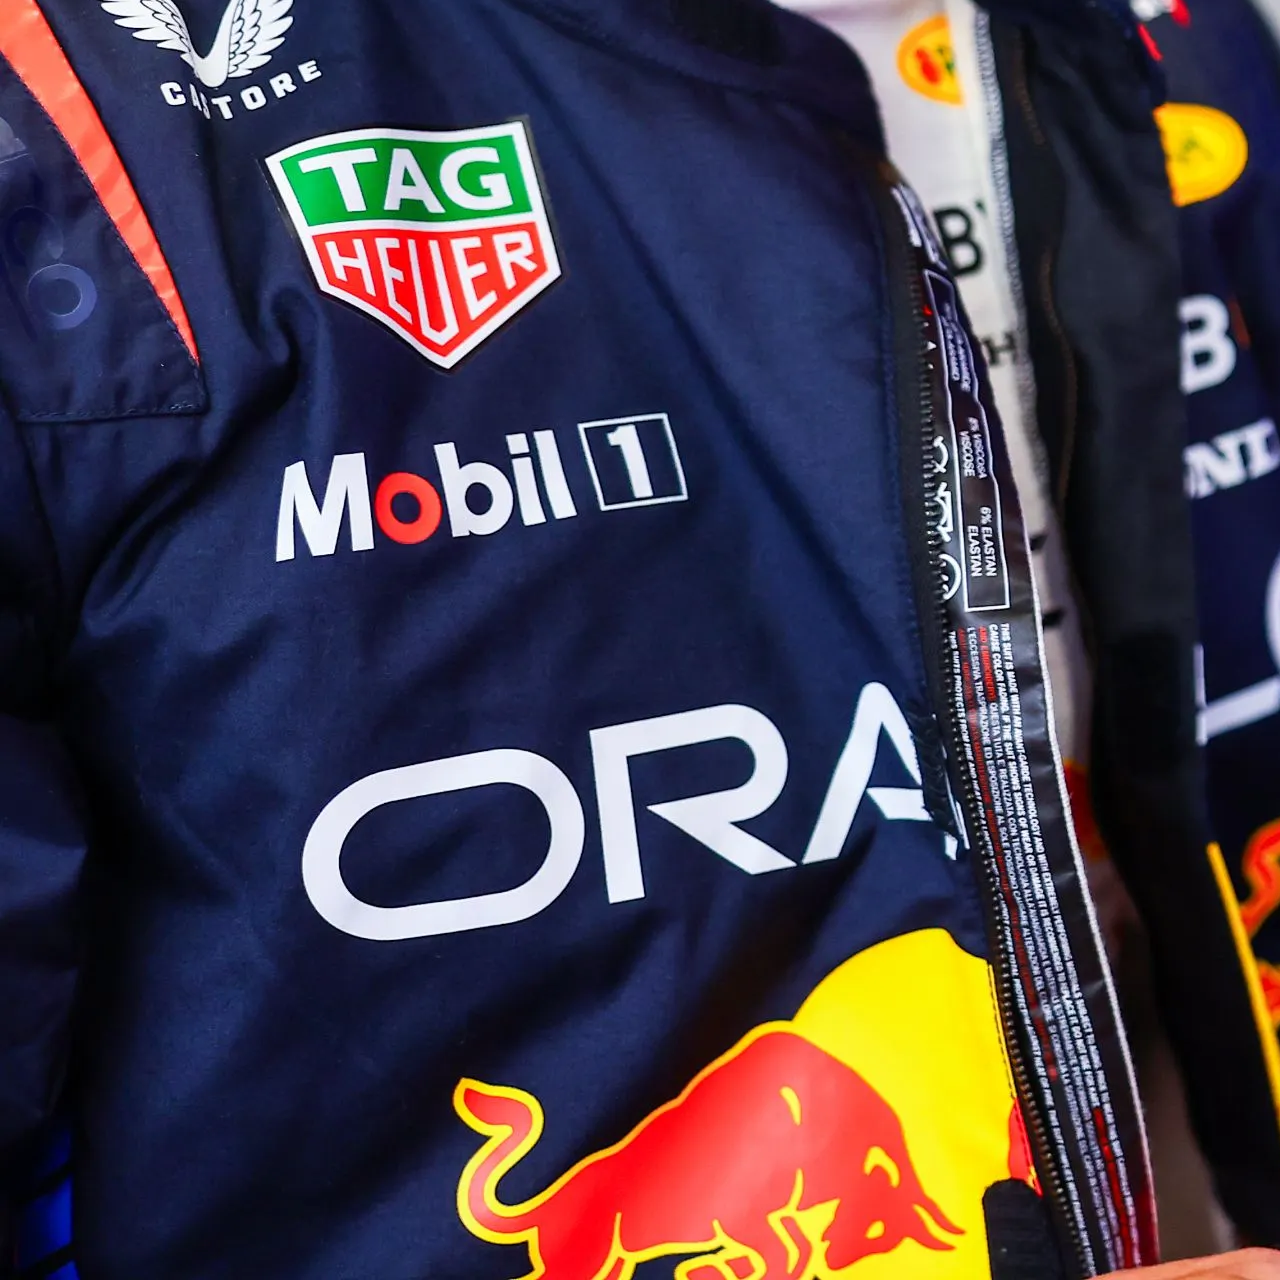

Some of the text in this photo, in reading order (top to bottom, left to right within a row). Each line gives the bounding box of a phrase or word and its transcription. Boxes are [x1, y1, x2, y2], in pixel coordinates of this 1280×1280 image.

[298, 146, 514, 214] TAG
[324, 230, 538, 346] HEUER
[275, 423, 653, 563] Mobil 1
[966, 524, 982, 577] ELASTAN
[979, 505, 996, 577] 6% ELASTAN
[988, 623, 1000, 652] CAUSE
[1000, 622, 1010, 641] THIS
[967, 626, 980, 680] L'ECCESSIVA
[1002, 642, 1012, 661] SUIT
[991, 652, 1004, 681] COLOR
[1004, 660, 1013, 670] IS
[1006, 670, 1018, 693] MADE
[953, 674, 965, 718] PROTECTS
[1010, 693, 1020, 715] WITH
[958, 718, 969, 742] FROM
[989, 702, 1000, 736] QUESTA
[1001, 713, 1010, 724] IF
[1002, 724, 1012, 741] THE
[983, 746, 993, 759] ED
[993, 737, 1003, 758] TUTA
[1003, 741, 1015, 759] SUIT
[1007, 759, 1020, 790] SHOWS
[985, 759, 1002, 815] ESPOSIZIONE
[998, 767, 1014, 816] REALIZZATA
[301, 681, 970, 940] ORA
[1013, 790, 1025, 816] SIGNS
[1023, 782, 1041, 836] TECHNOLOGY
[996, 814, 1004, 825] AL
[1007, 816, 1018, 836] CON
[1018, 816, 1028, 829] OF
[998, 826, 1009, 848] SOLE
[1020, 829, 1033, 854] WEAR
[1033, 835, 1044, 853] AND
[1003, 849, 1018, 889] POSSONO
[1011, 837, 1030, 888] TECNOLOGIA
[1026, 853, 1036, 867] OR
[1037, 853, 1049, 872] WITH
[1028, 866, 1044, 900] DAMAGE
[1037, 899, 1047, 908] IT
[1039, 908, 1049, 916] IS
